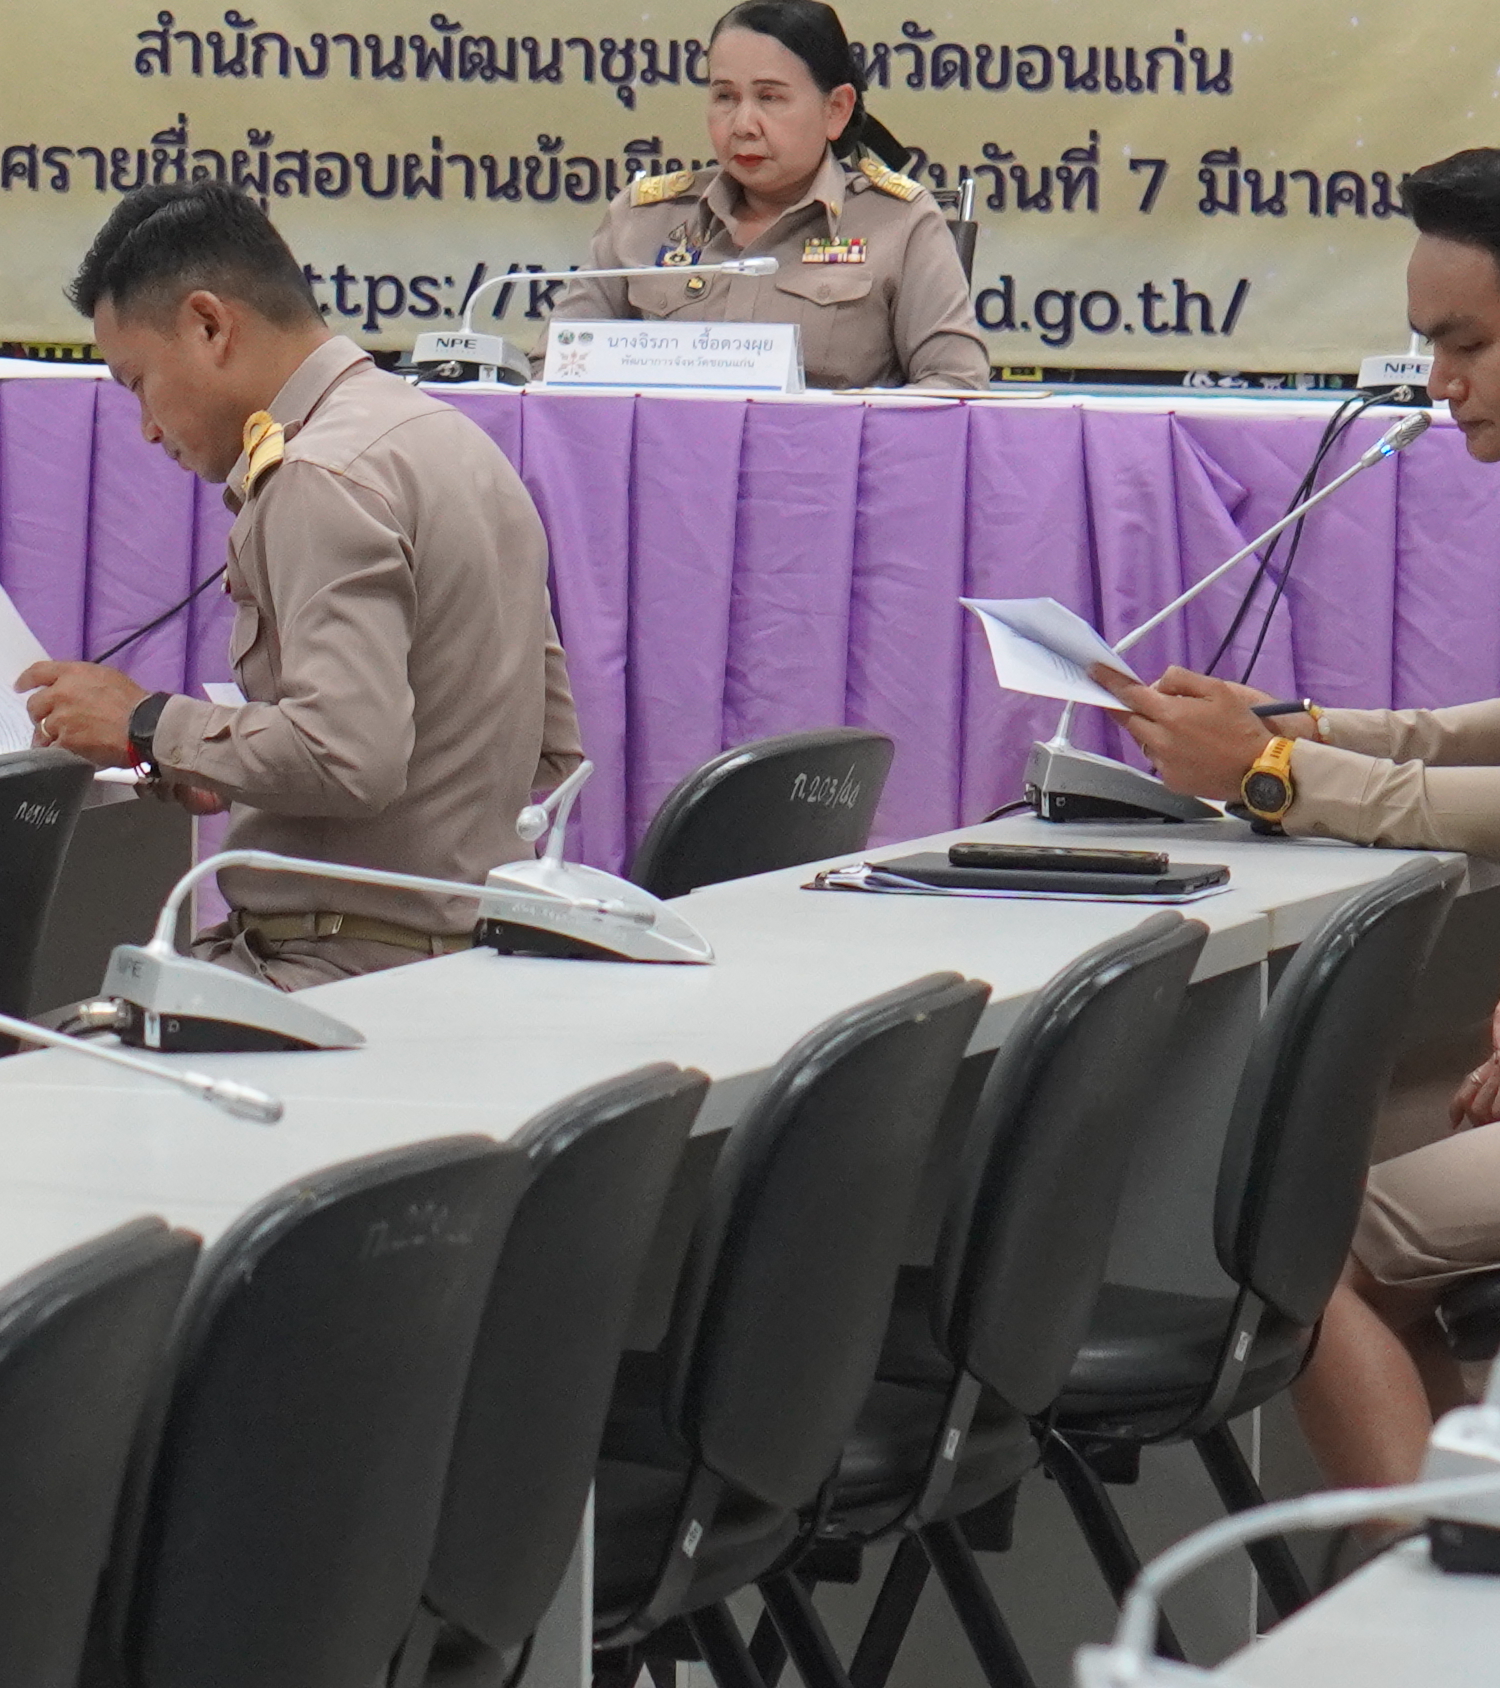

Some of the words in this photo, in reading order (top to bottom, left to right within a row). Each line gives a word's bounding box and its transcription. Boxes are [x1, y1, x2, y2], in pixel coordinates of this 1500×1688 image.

[134, 9, 1234, 110] สำนักงานพัฒนาชุมชหวัดขอนแก่น
[1128, 157, 1170, 216] 7
[436, 337, 478, 350] NPE
[1384, 362, 1430, 375] NPE
